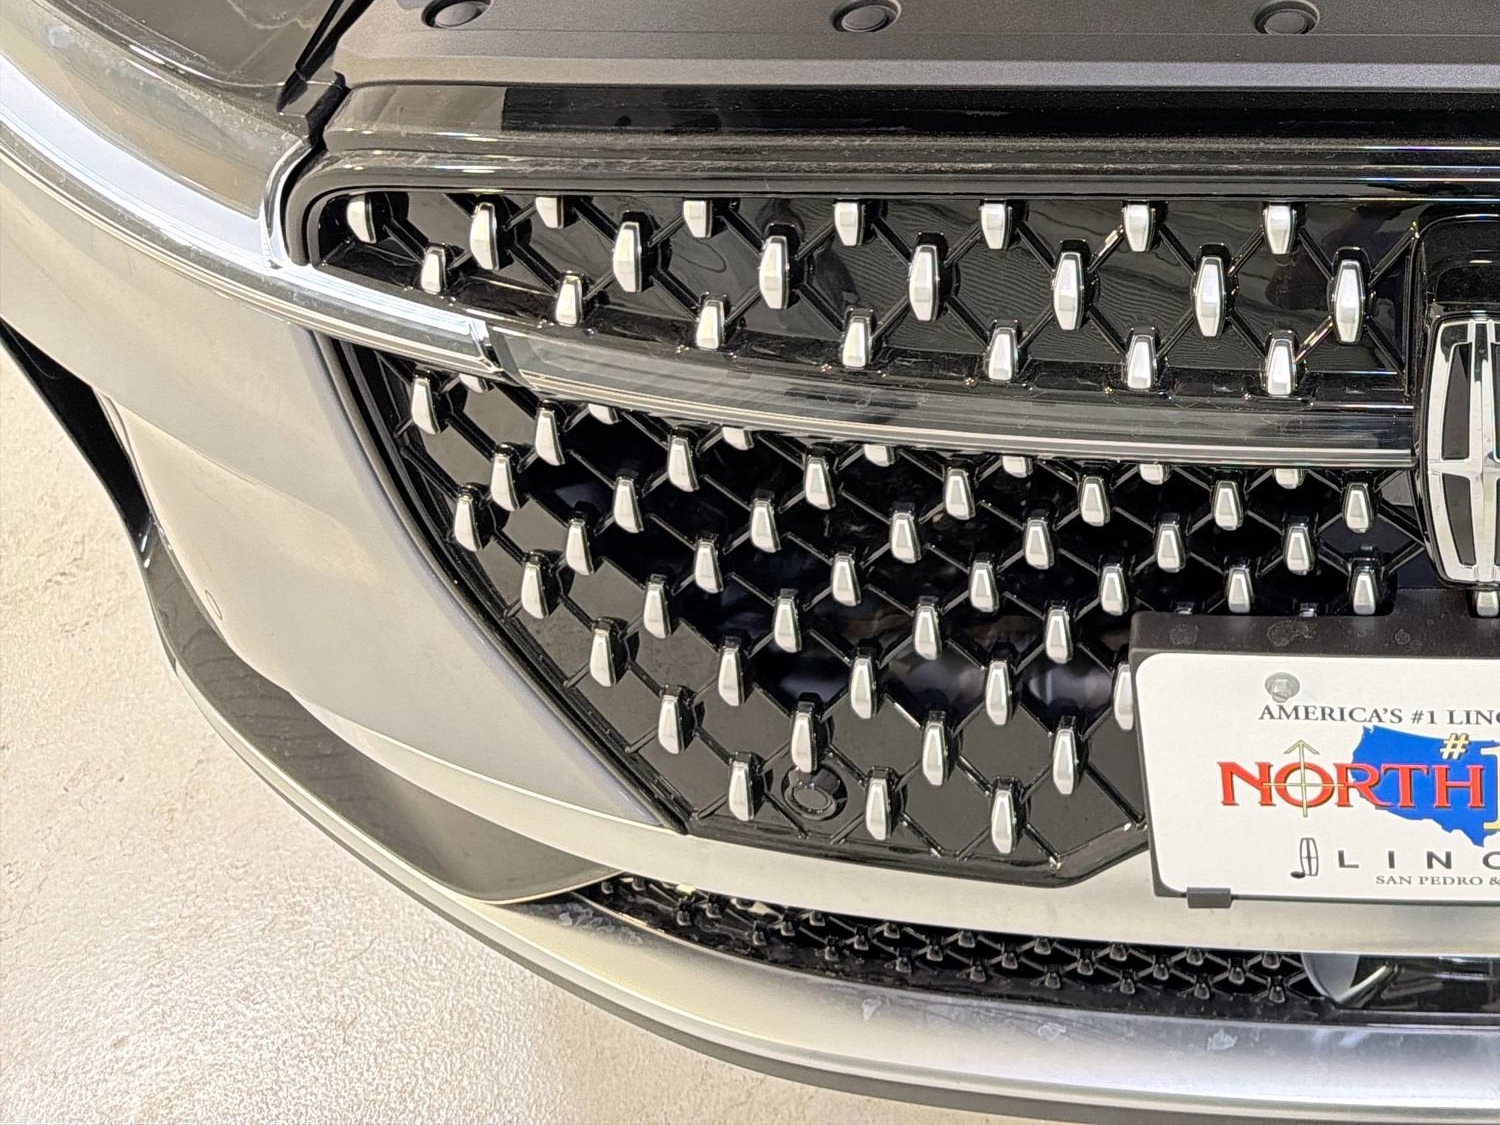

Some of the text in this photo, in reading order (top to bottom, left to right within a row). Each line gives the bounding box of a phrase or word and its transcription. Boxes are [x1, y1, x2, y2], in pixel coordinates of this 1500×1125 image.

[1258, 704, 1403, 724] AMERICA'S
[1410, 709, 1438, 725] #1
[1217, 760, 1485, 809] NORTH
[1375, 874, 1414, 886] SAN
[1417, 875, 1484, 887] PEDRO
